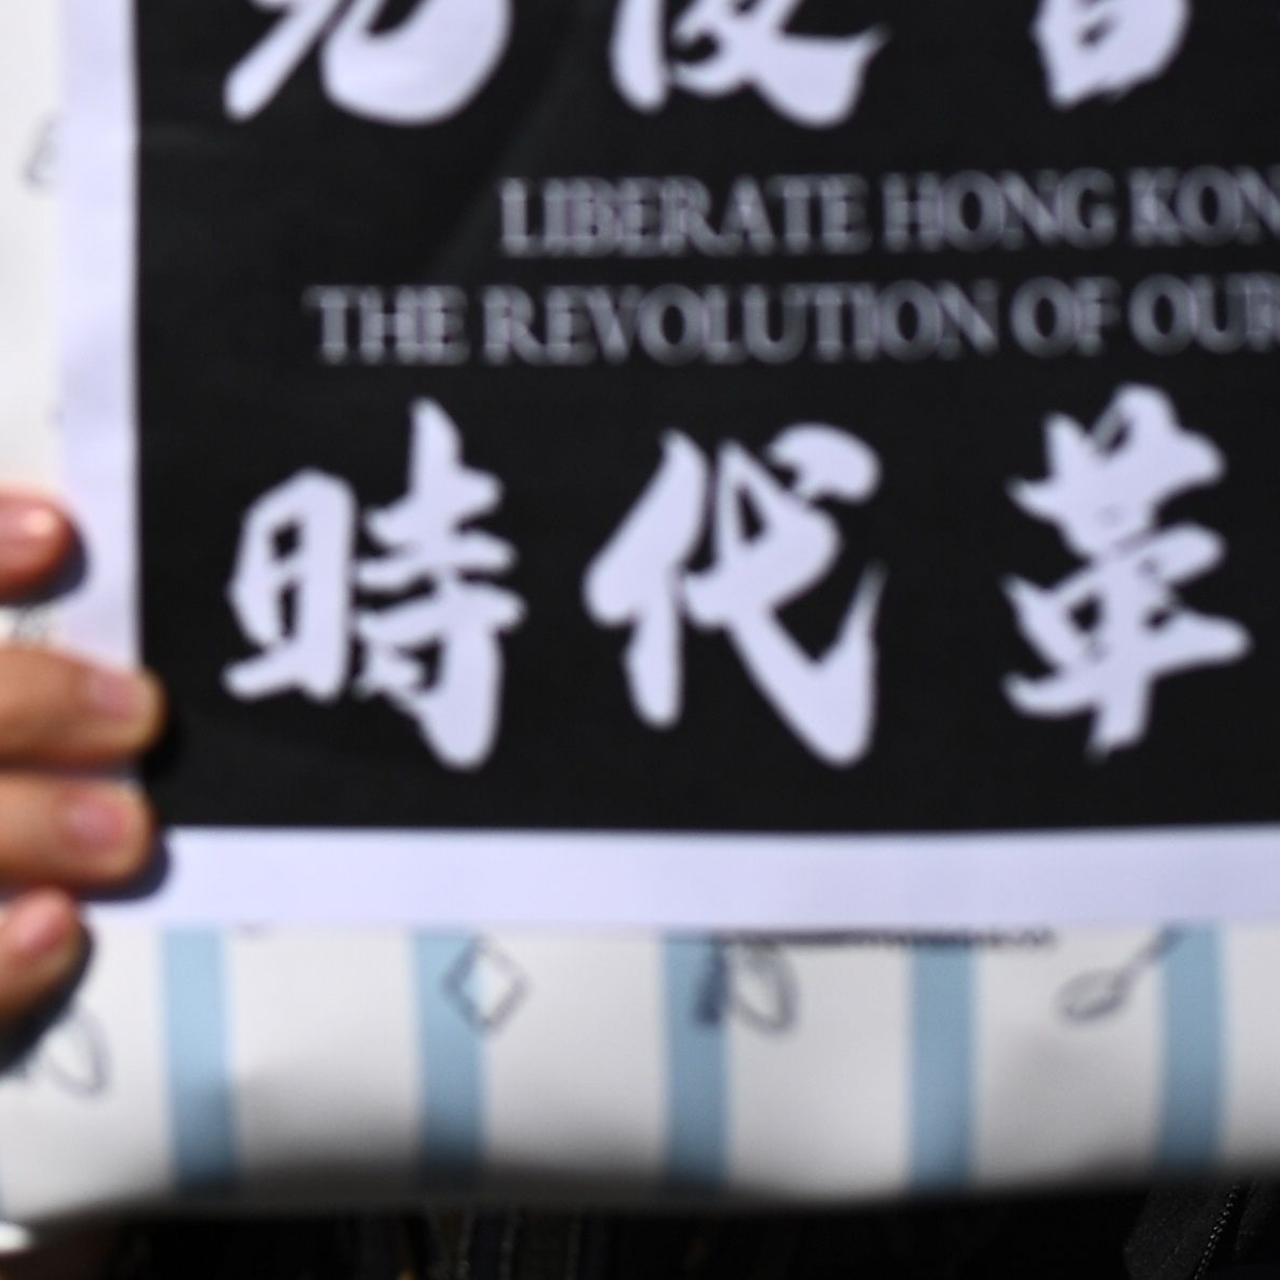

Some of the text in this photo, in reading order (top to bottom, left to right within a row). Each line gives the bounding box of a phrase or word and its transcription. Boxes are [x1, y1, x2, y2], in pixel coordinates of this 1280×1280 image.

[498, 173, 870, 259] LIBERATE
[882, 169, 1117, 252] HONG
[305, 284, 470, 366] THE
[482, 280, 998, 365] REVOLUTION
[1010, 276, 1118, 356] OF
[225, 385, 1250, 768] 時代革
